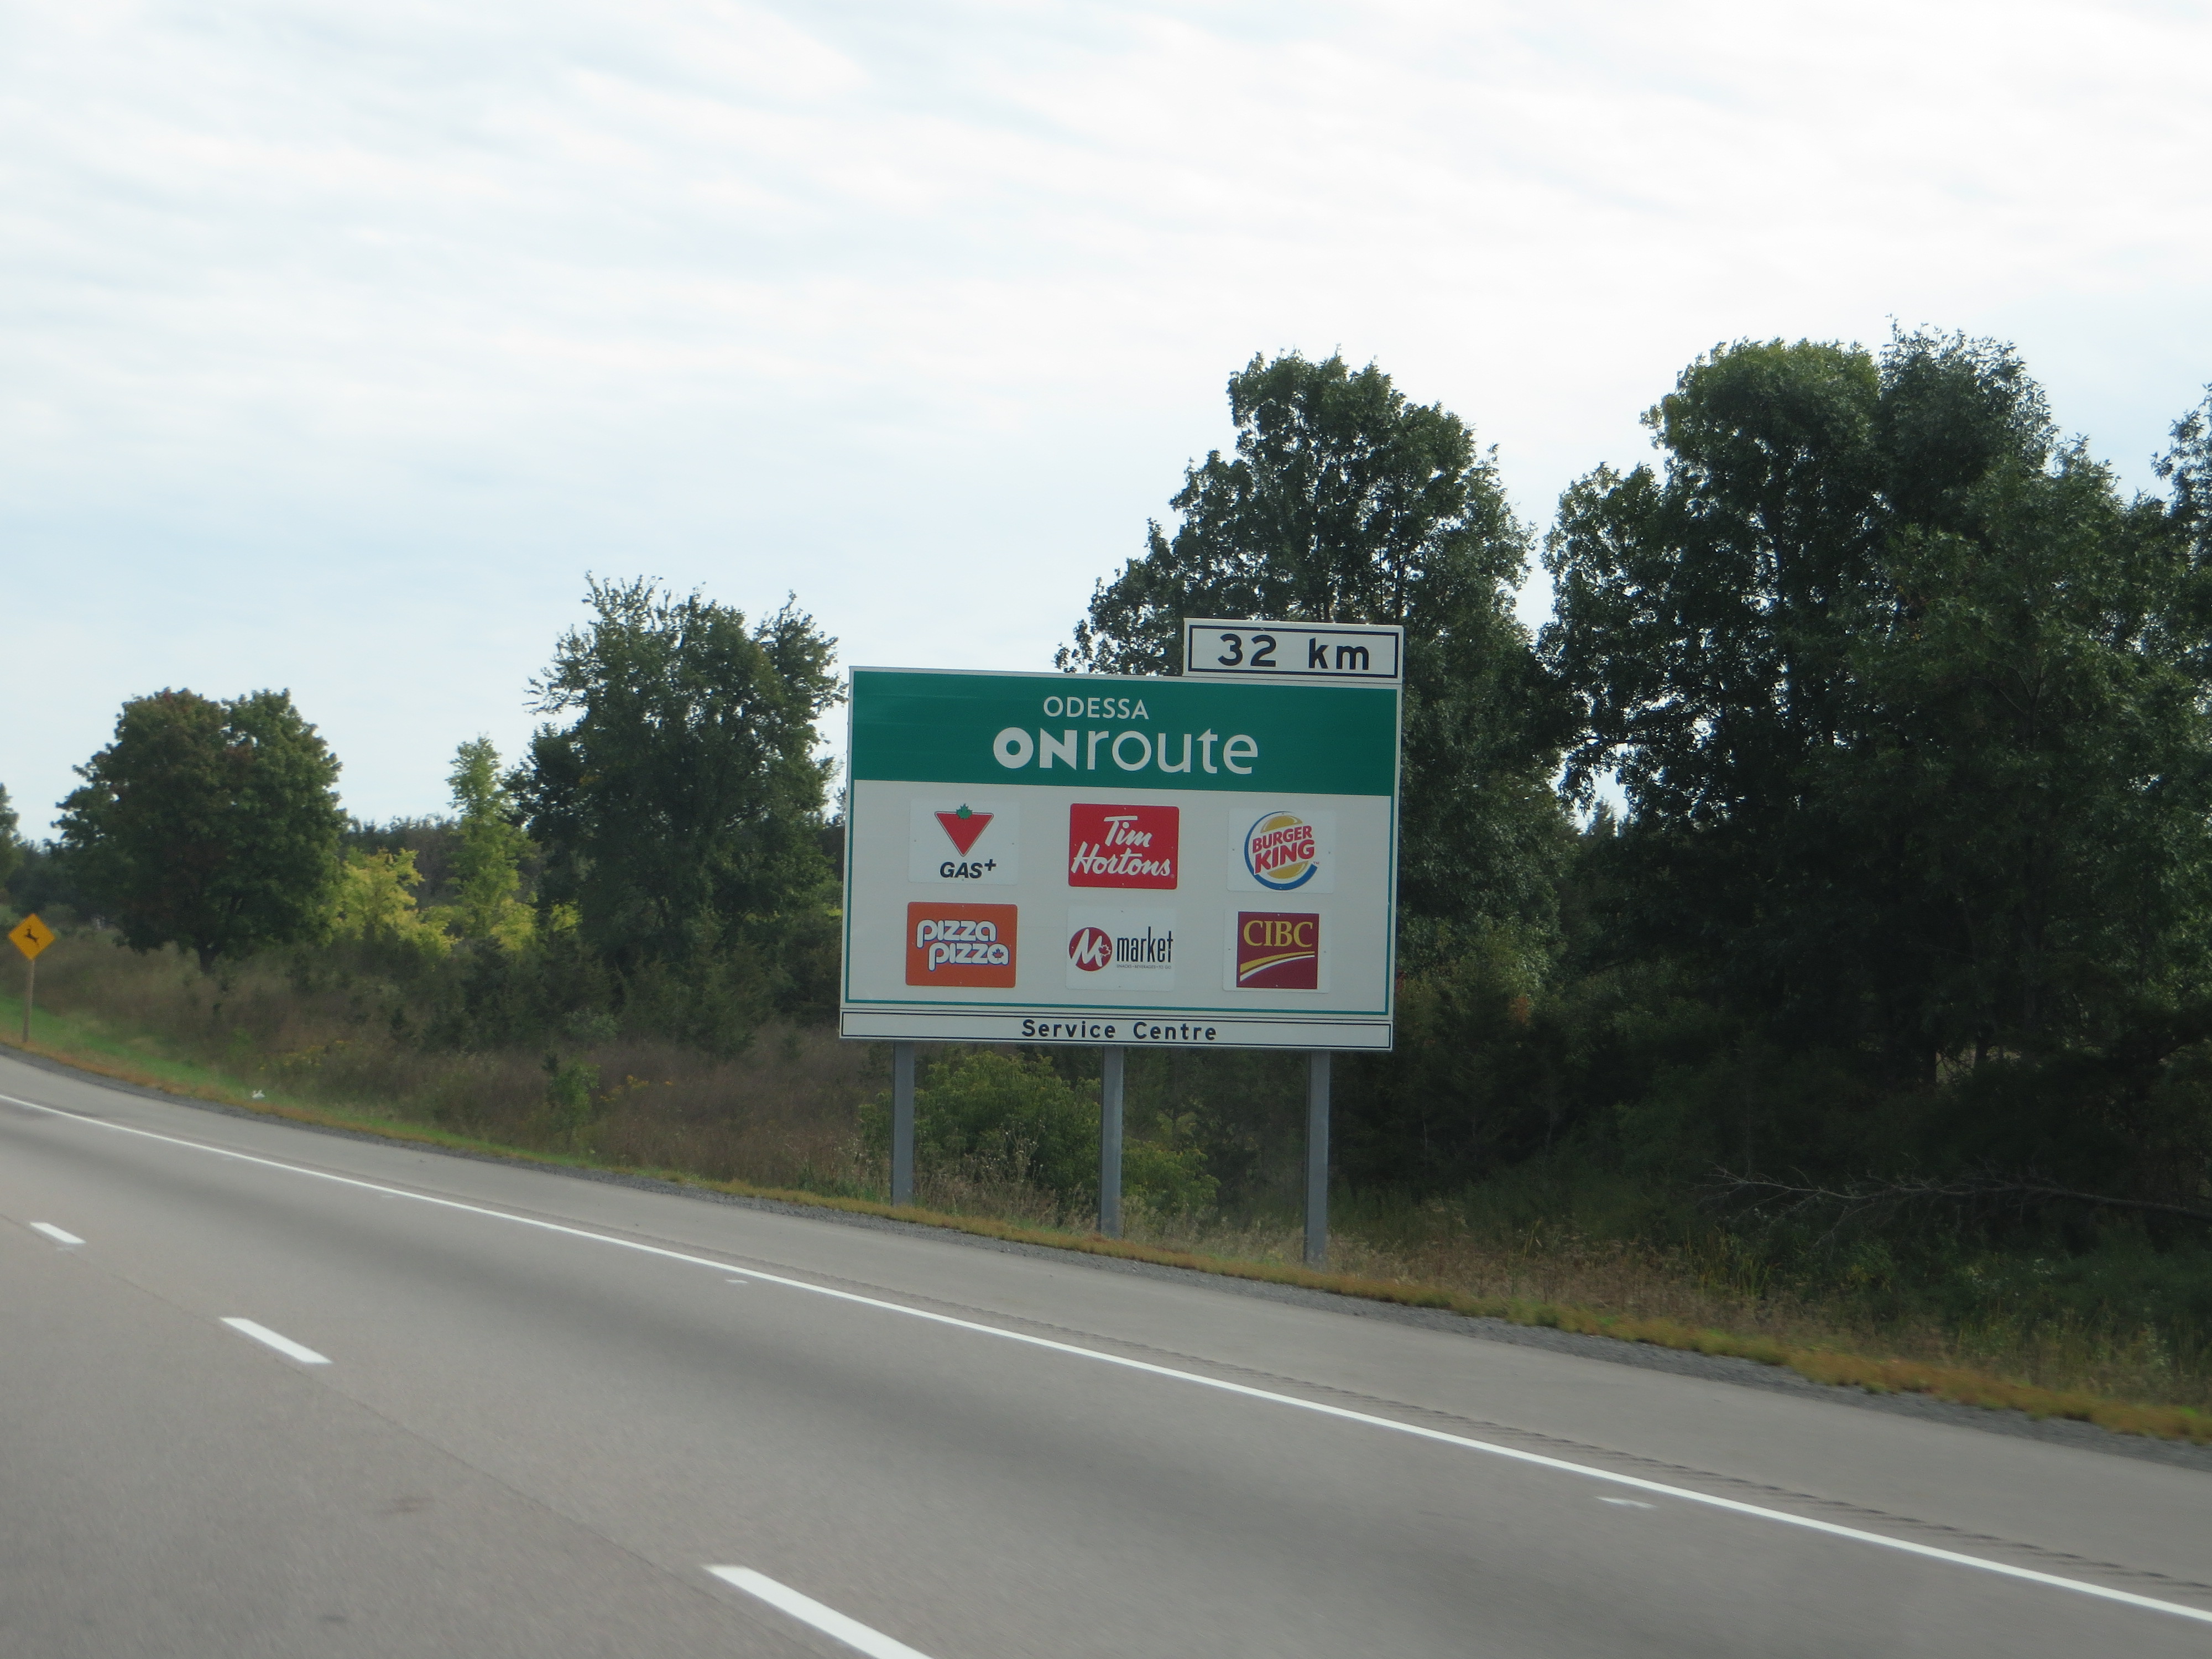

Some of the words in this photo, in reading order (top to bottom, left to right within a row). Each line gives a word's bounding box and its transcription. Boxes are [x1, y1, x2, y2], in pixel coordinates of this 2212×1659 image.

[1217, 633, 1276, 667] 32
[1308, 637, 1369, 670] km
[1043, 696, 1149, 719] ODESSA
[993, 727, 1258, 775] ONroute
[1103, 815, 1152, 847] Tim
[1252, 825, 1312, 854] BURGER
[1071, 841, 1171, 876] Hortons
[1255, 839, 1315, 874] KING
[916, 919, 997, 948] pizza
[1117, 926, 1173, 963] market
[1244, 920, 1313, 947] CIBC
[1022, 1019, 1116, 1039] Service
[1133, 1021, 1216, 1040] Centre
